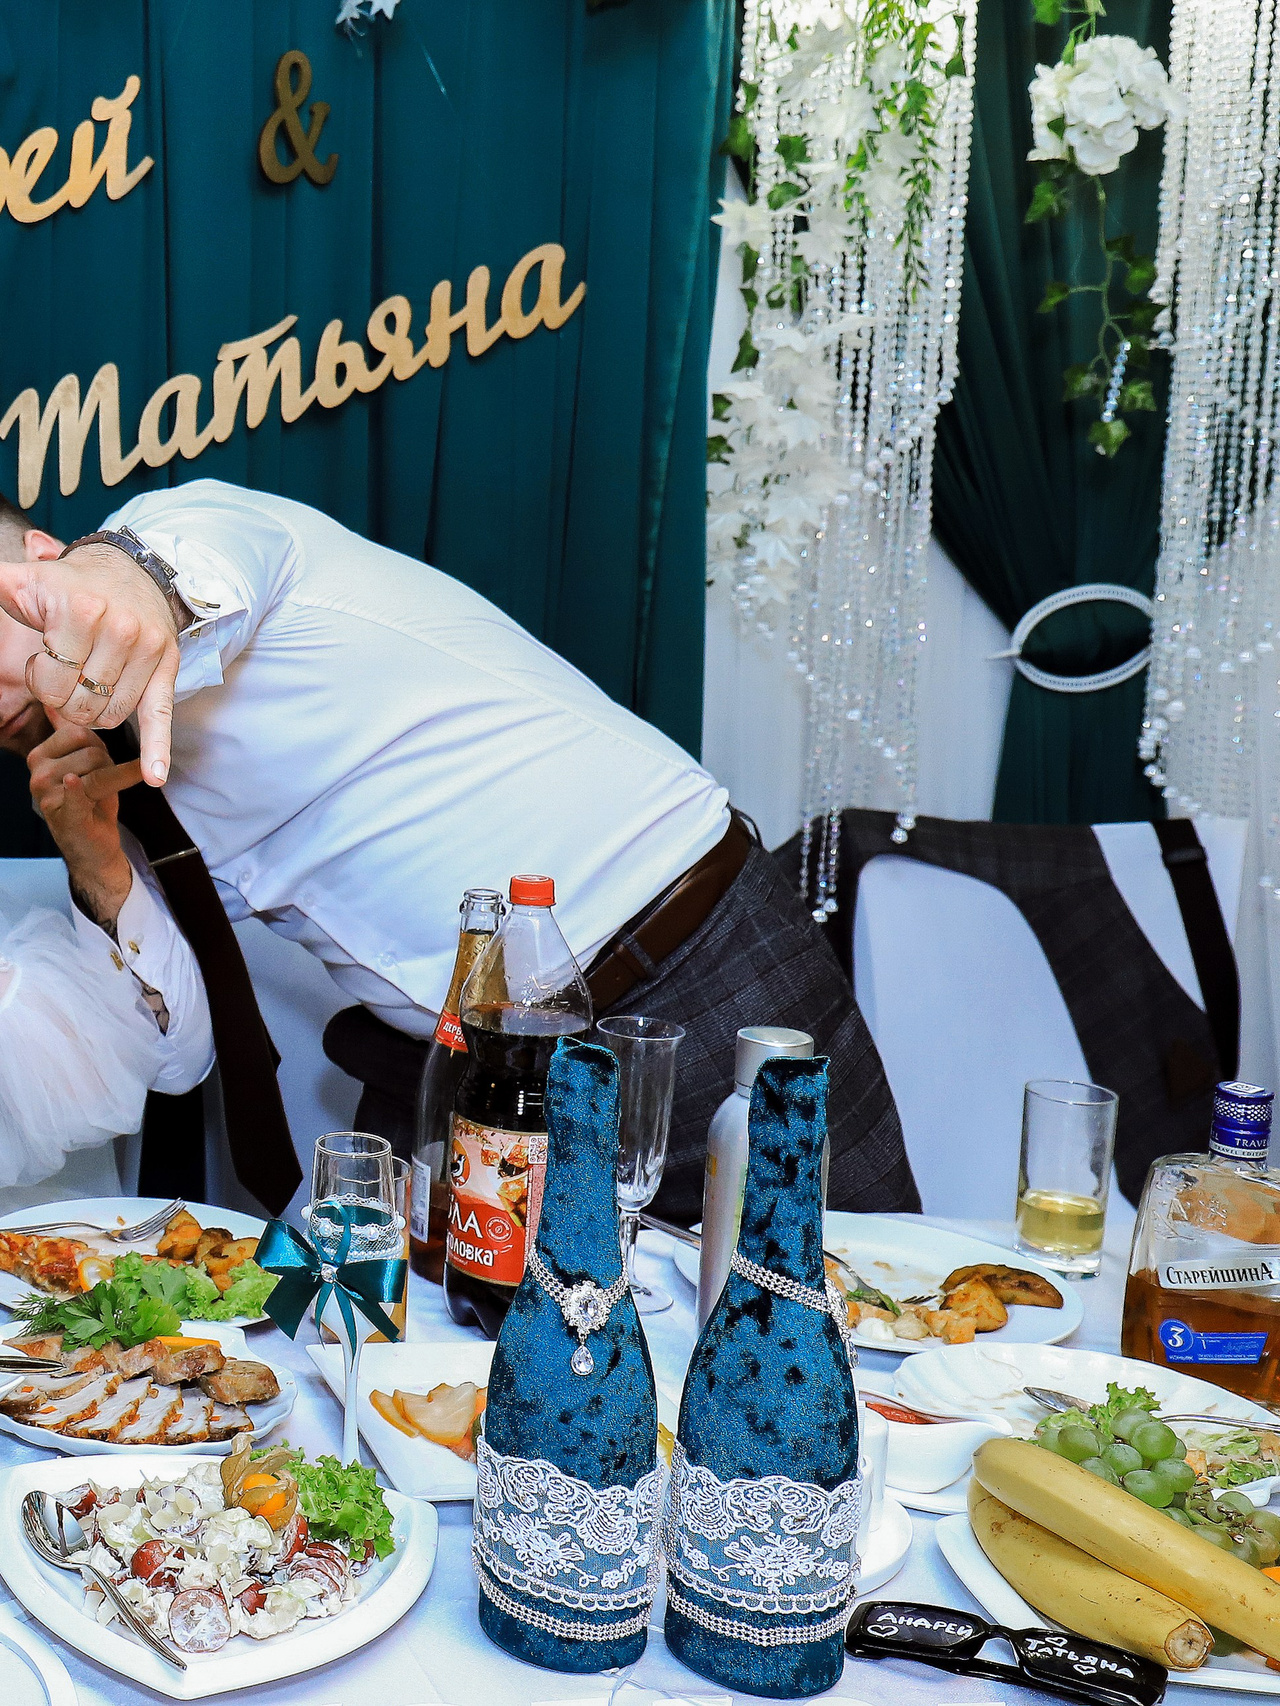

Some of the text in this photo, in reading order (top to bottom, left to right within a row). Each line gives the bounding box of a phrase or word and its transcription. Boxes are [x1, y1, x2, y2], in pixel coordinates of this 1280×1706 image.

[257, 48, 339, 185] &
[442, 1021, 464, 1037] ДЕРБ
[1167, 1325, 1185, 1348] 3
[1024, 1637, 1135, 1679] ТАТЬЯНА
